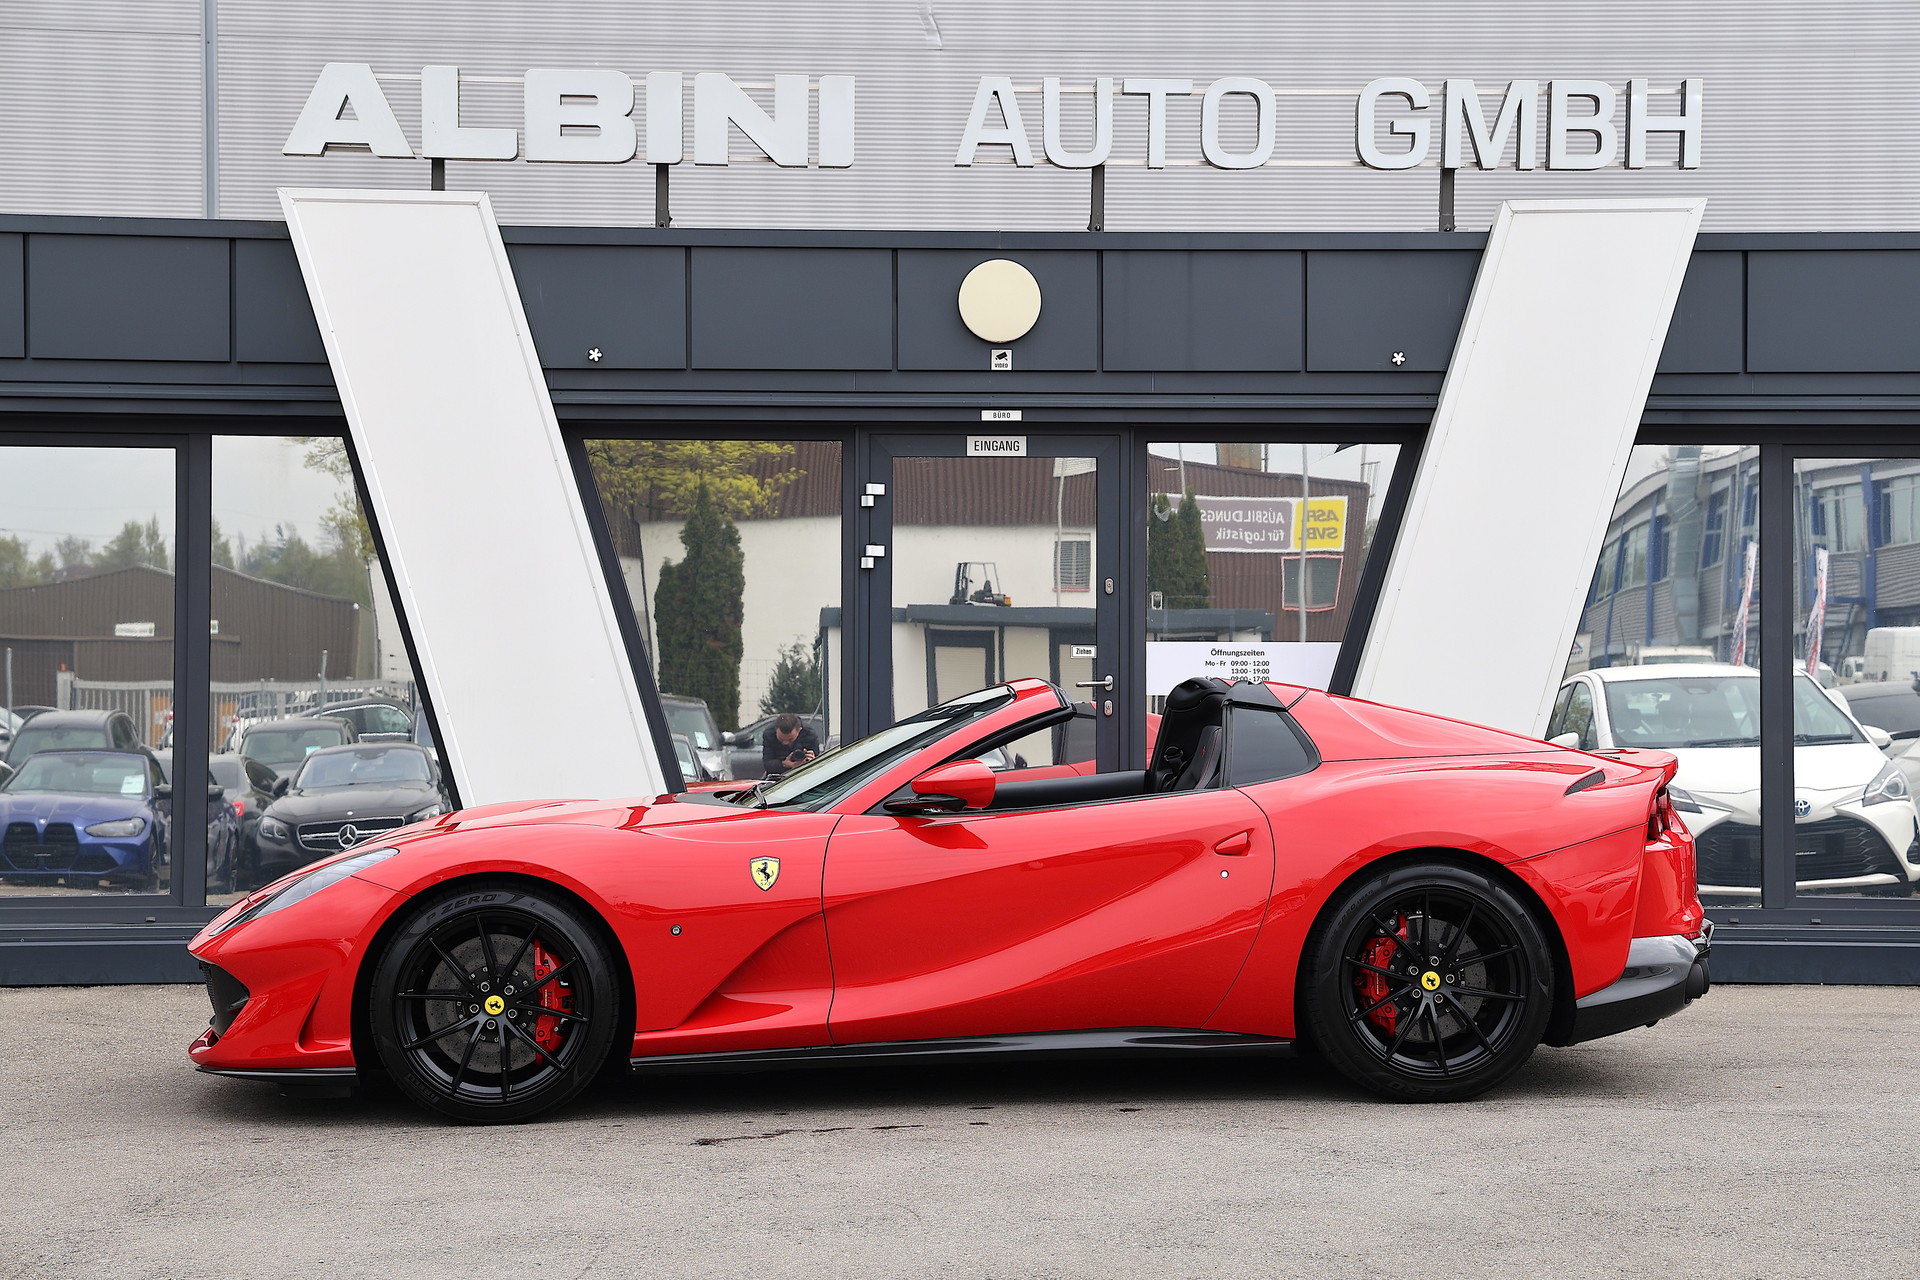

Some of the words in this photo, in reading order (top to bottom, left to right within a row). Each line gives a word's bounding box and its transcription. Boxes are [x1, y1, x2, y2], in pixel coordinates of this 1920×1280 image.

[281, 62, 855, 169] ALBINI
[954, 76, 1276, 170] AUTO
[1355, 77, 1703, 171] GMBH
[993, 411, 1011, 419] BÜRO
[974, 440, 1020, 452] EINGANG
[1210, 648, 1265, 657] Öffnungszeiten
[425, 911, 436, 925] P
[441, 893, 498, 914] ZERO
